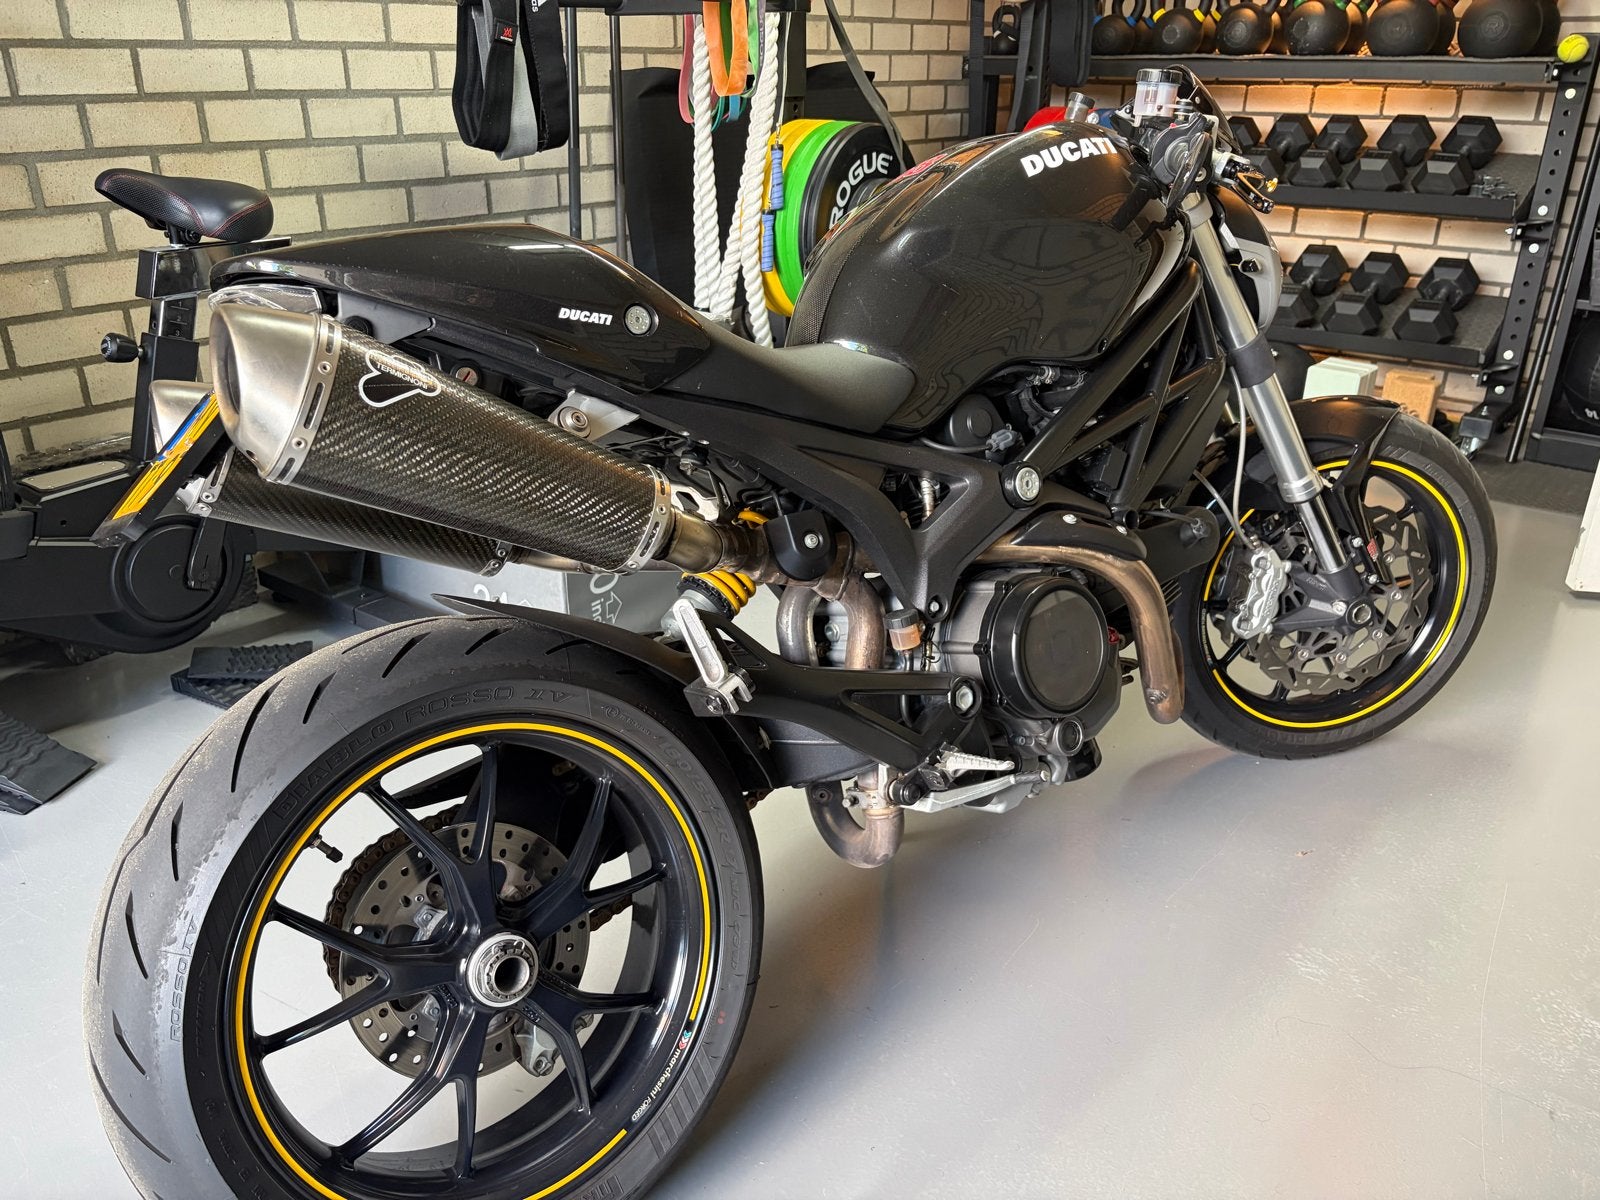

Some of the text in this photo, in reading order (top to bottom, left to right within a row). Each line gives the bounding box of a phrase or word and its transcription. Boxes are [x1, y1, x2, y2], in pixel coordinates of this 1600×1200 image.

[828, 151, 892, 230] ROGUE
[1020, 137, 1118, 178] DUCATI
[558, 307, 613, 326] DUCATI
[376, 361, 428, 390] TERMIGNONI
[273, 715, 394, 821] DIABLO
[404, 684, 515, 725] ROSSO
[169, 956, 189, 1043] ROSSO
[631, 1048, 681, 1122] marchesini FORGED
